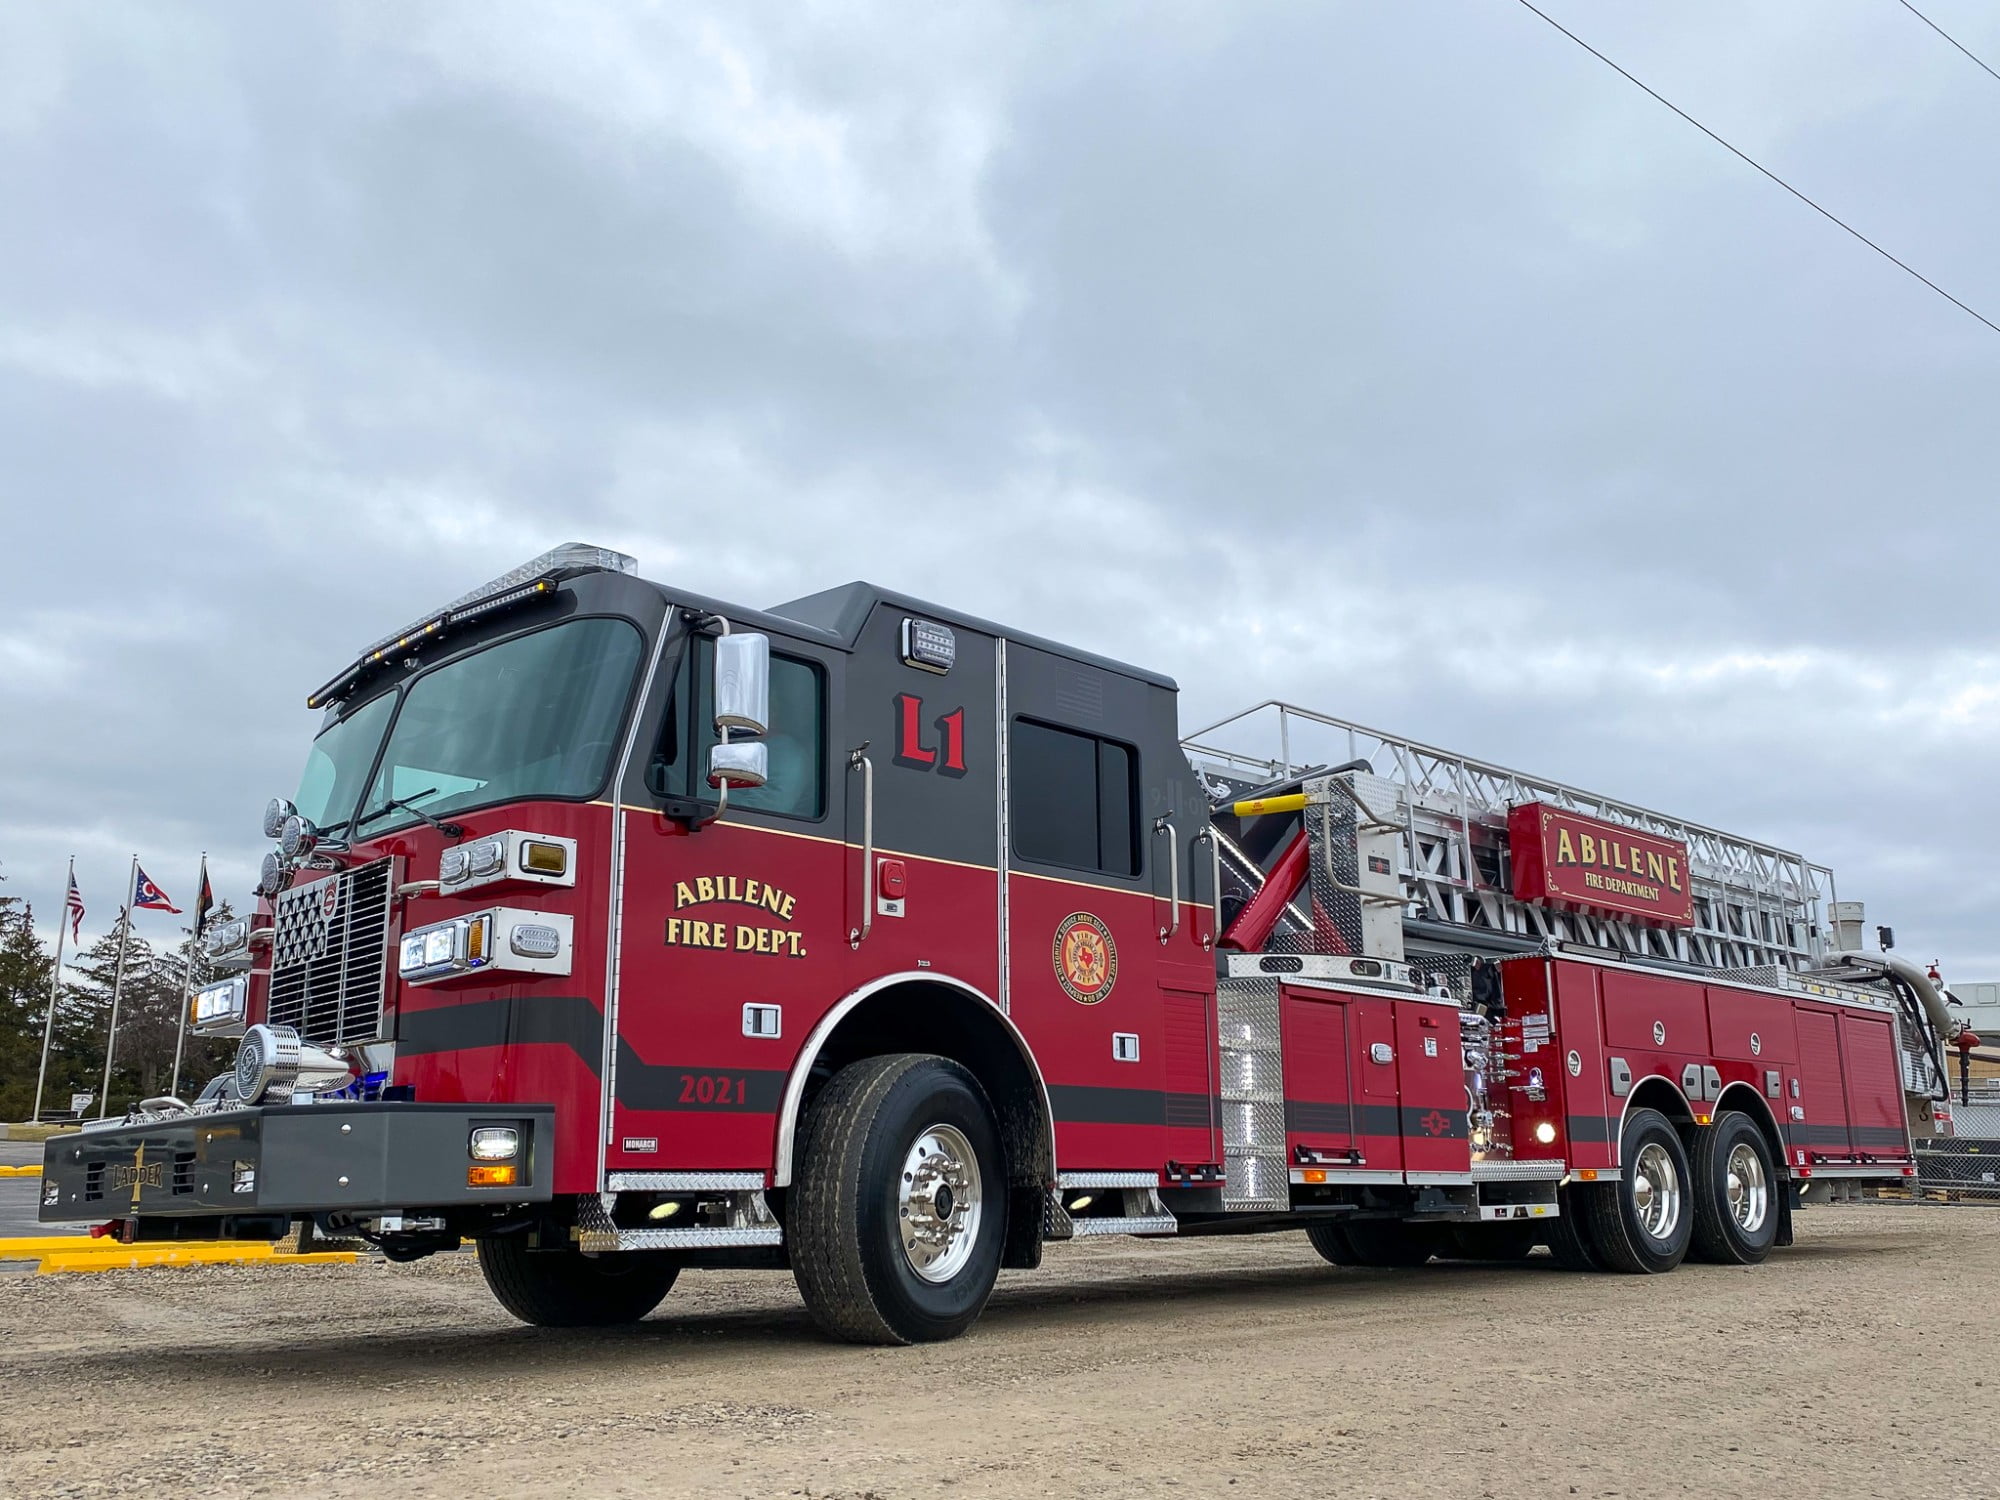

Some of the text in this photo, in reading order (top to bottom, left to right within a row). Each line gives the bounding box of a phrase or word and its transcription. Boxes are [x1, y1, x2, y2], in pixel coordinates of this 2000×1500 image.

[895, 693, 967, 775] L1
[1556, 828, 1682, 894] ABILENE
[674, 875, 797, 921] ABILENE
[1584, 871, 1660, 902] FIRE DEPARTMENT
[1077, 914, 1093, 923] ABOVE
[666, 917, 807, 957] FIRE DEPT.
[678, 1075, 745, 1105] 2021
[625, 1139, 656, 1149] MONARCH
[112, 1162, 163, 1191] LADDER
